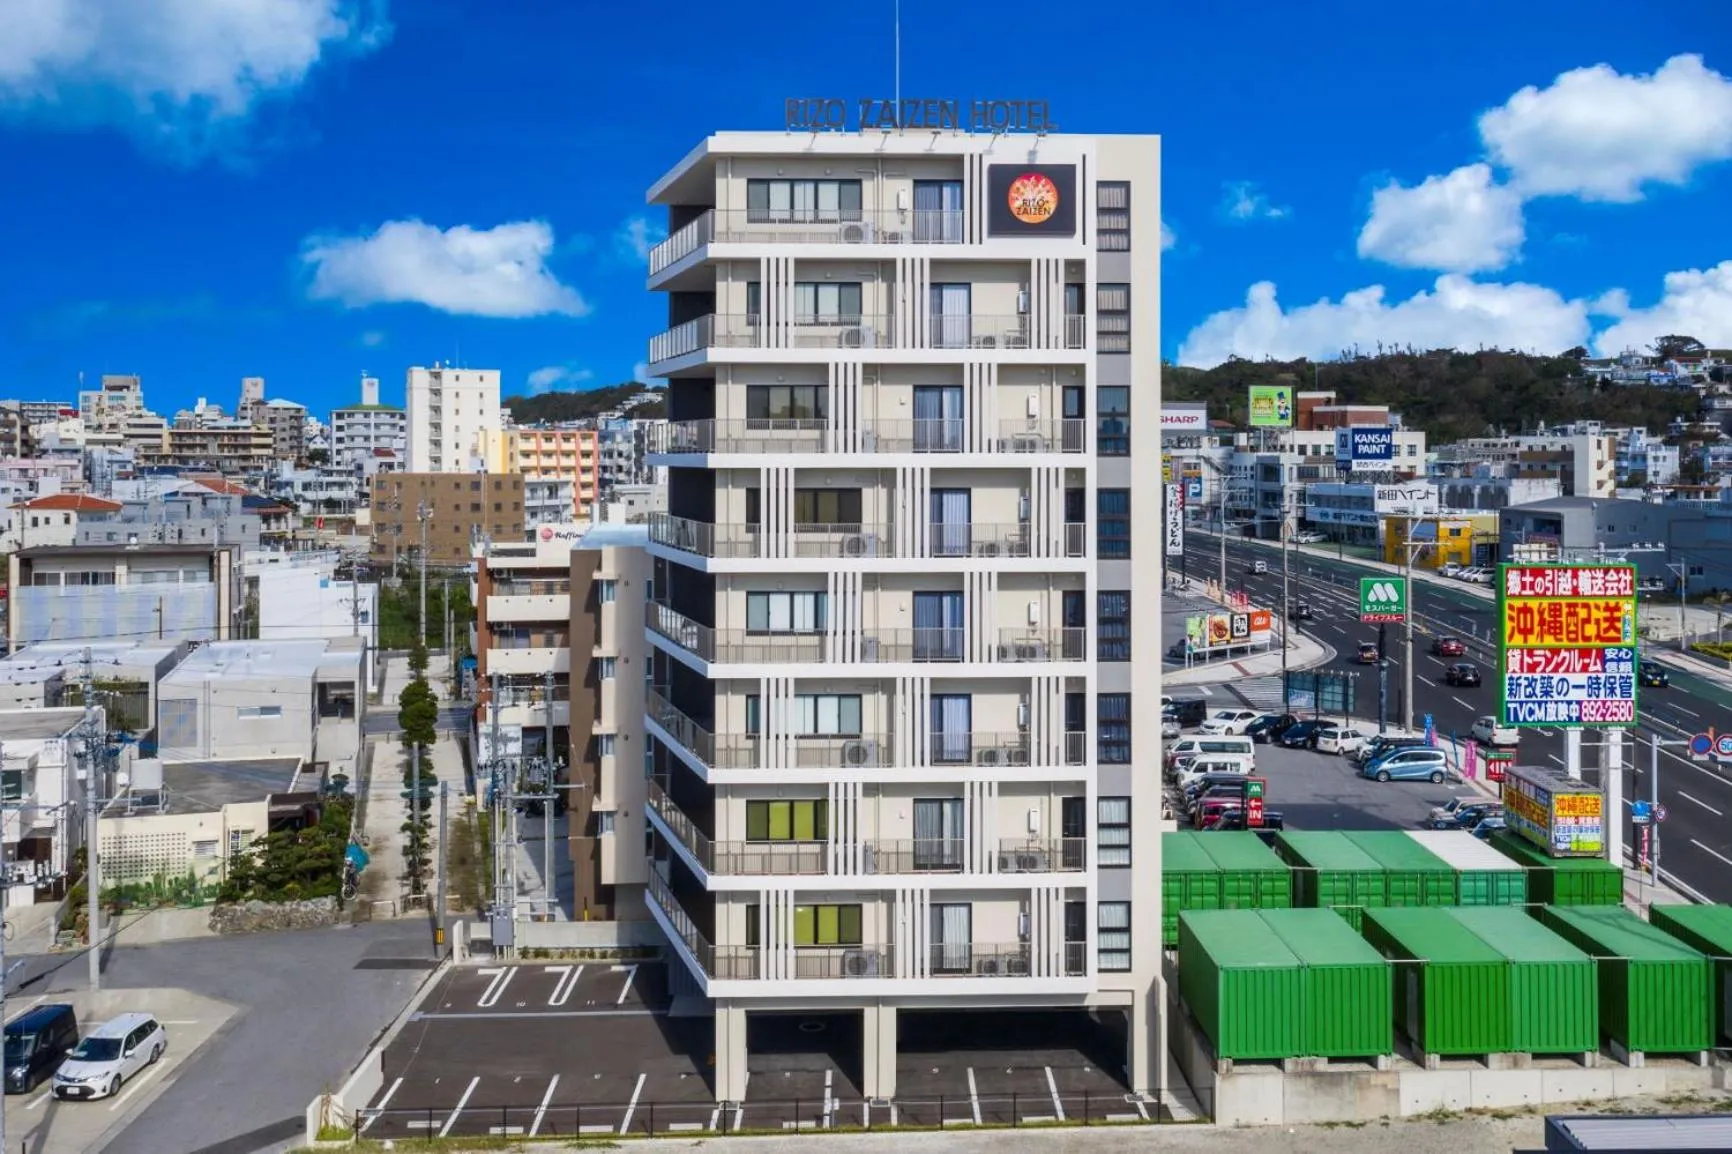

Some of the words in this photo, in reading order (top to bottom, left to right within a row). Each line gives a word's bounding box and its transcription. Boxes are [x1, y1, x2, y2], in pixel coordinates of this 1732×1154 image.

[785, 98, 846, 128] RIZO
[858, 98, 959, 129] ZAIZEN
[970, 100, 1059, 130] HOTEL
[1022, 199, 1046, 208] RIZO
[1016, 207, 1052, 216] ZAIZEN
[1354, 433, 1391, 444] KANSAI
[1358, 444, 1386, 454] PAINT
[1188, 483, 1201, 498] P
[1376, 489, 1436, 501] 新田ペイント
[1507, 569, 1633, 596] 郷土の引越・輸送会社
[1364, 604, 1403, 612] モスバーガー
[1507, 602, 1622, 644] 沖縄配送
[1507, 649, 1602, 673] 貸トランクルーム
[1507, 675, 1633, 699] 新改築の一時保管
[1581, 701, 1634, 722] 892-2580
[1249, 809, 1262, 820] IN
